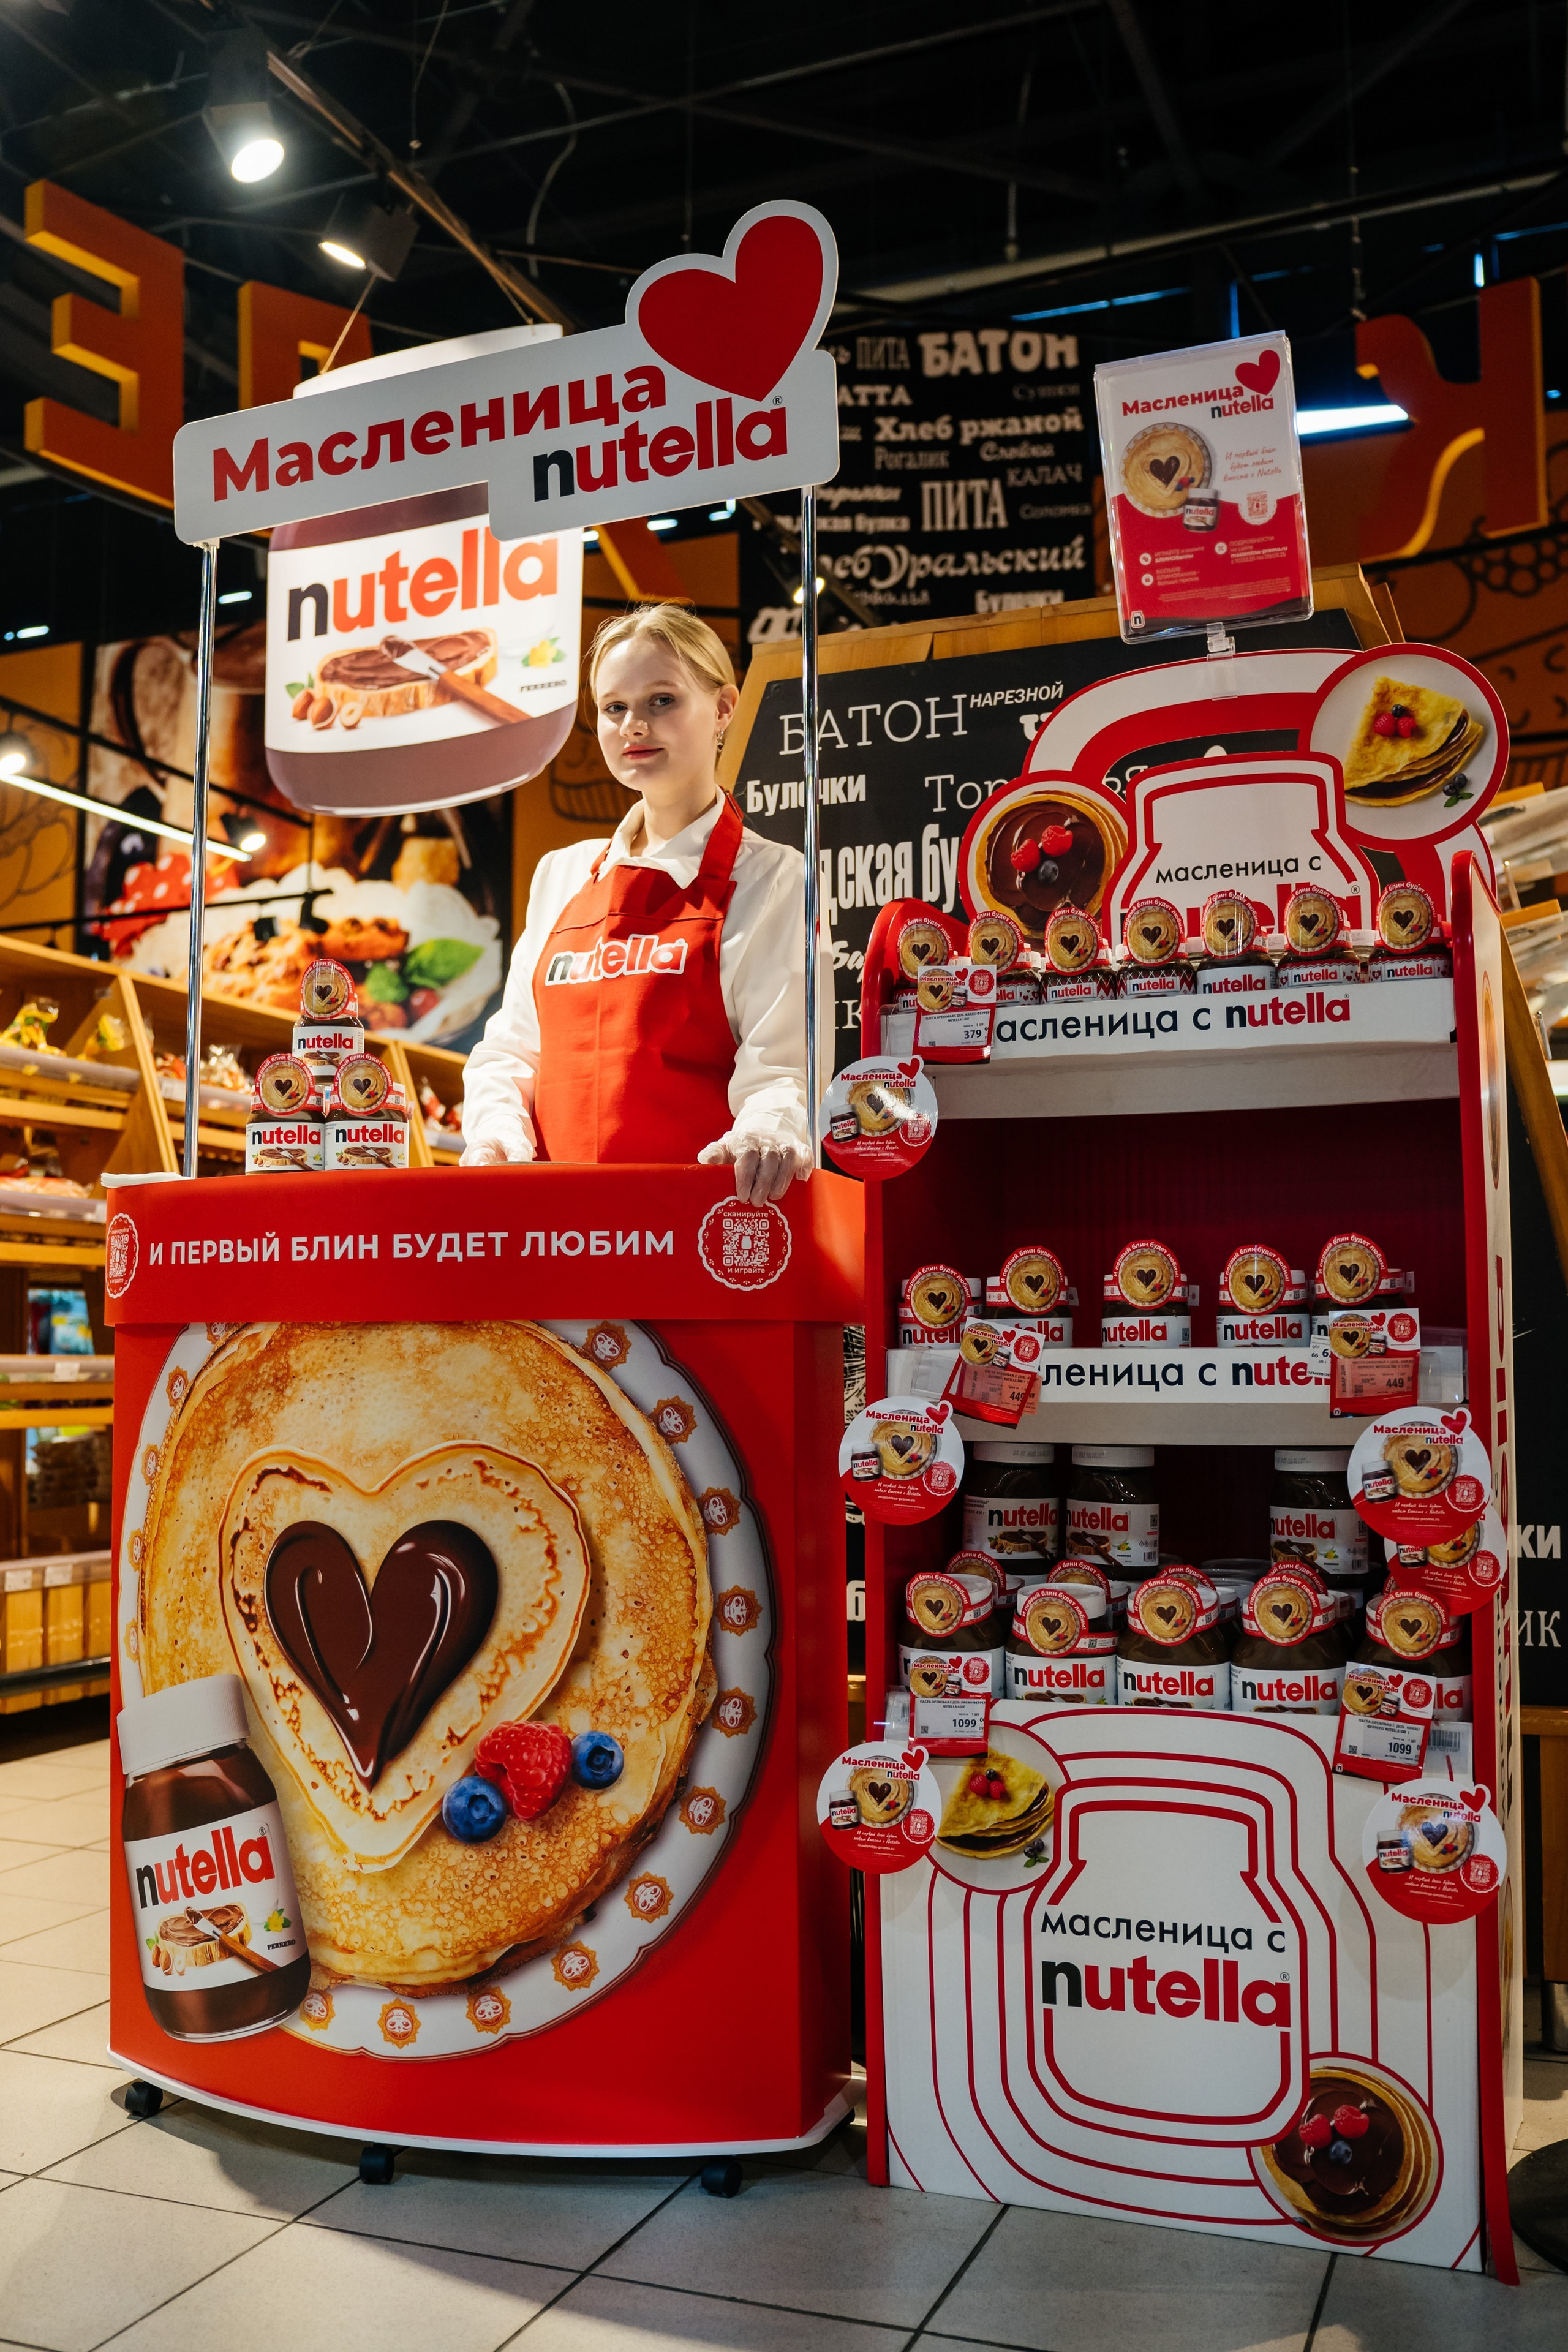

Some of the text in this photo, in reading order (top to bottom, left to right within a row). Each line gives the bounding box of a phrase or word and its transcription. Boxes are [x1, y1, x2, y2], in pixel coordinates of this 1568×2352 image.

[918, 329, 1079, 378] БАТОН
[1121, 386, 1244, 417] Масленица
[1211, 394, 1274, 419] nutella
[213, 365, 666, 502] Масленица
[874, 414, 954, 442] Хлеб
[959, 406, 1084, 446] ржаной
[1006, 463, 1083, 488] КАЛАЧ
[921, 479, 1008, 532] ПИТА
[287, 526, 558, 641] nutella
[779, 694, 967, 756] БАТОН
[970, 681, 1064, 709] НАРЕЗНОЙ
[1156, 857, 1299, 884] масленица
[548, 937, 685, 982] nutella
[1294, 968, 1338, 983] nutella
[1387, 964, 1433, 978] nutella
[1051, 986, 1091, 999] nutella
[1132, 978, 1175, 992] nutella
[1202, 974, 1266, 994] nutella
[996, 989, 1015, 1001] ella
[996, 1010, 1178, 1042] асленица
[1226, 992, 1351, 1029] nutella
[298, 1033, 354, 1049] nutella
[964, 1029, 982, 1039] 379
[841, 1072, 902, 1081] Масленица
[884, 1079, 916, 1088] nutella
[252, 1125, 322, 1145] nutella
[336, 1123, 405, 1144] nutella
[723, 1210, 769, 1219] сканируйте
[149, 1231, 673, 1265] И ПЕРВЫЙ БЛИН БУДЕТ ЛЮБИМ
[734, 1266, 765, 1275] играйте
[967, 1328, 1003, 1341] Масленица
[1224, 1317, 1302, 1340] nutella
[1039, 1362, 1183, 1392] леница
[1232, 1355, 1326, 1386] nute
[1386, 1378, 1404, 1388] 449
[866, 1410, 930, 1424] Масленица
[910, 1423, 944, 1434] nutella
[1373, 1425, 1446, 1435] Масленица
[1425, 1435, 1463, 1444] nutella
[988, 1502, 1058, 1526] nutella
[1014, 1663, 1106, 1689] nutella
[1123, 1671, 1214, 1696] nutella
[1349, 1673, 1390, 1686] Масленица
[1242, 1675, 1338, 1702] nutella
[952, 1719, 976, 1728] 1099
[1388, 1742, 1411, 1755] 1099
[842, 1756, 906, 1770] Масленица
[887, 1771, 920, 1781] nutella
[1391, 1792, 1464, 1811] Масленица
[136, 1826, 275, 1909] nutella
[1041, 1910, 1285, 1954] масленица с
[267, 1939, 296, 1950] FERRERO
[1041, 1955, 1291, 2028] nutella
